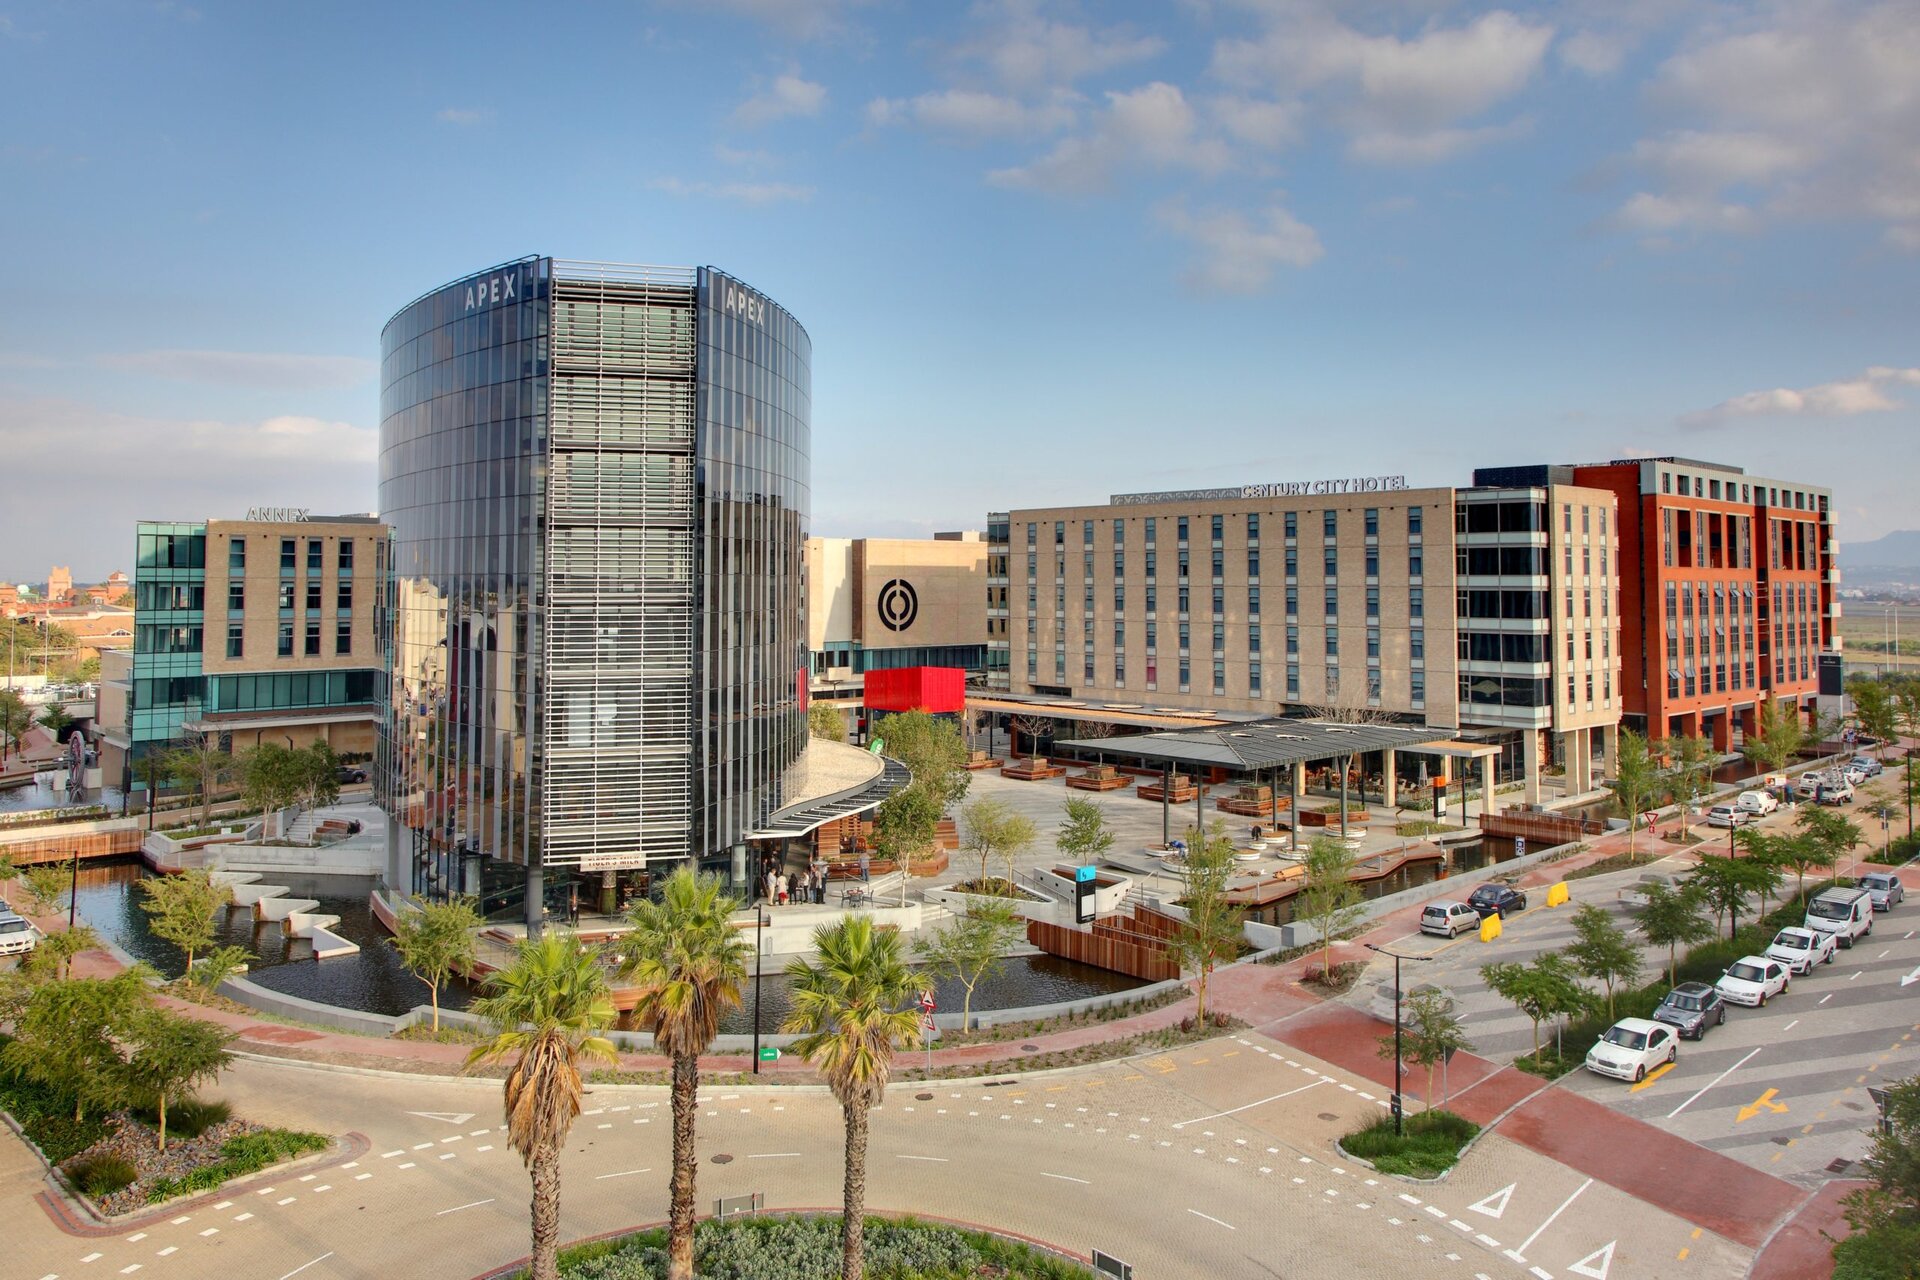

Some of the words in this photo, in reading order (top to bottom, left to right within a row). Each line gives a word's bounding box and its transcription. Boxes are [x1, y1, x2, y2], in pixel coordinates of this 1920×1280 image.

[465, 273, 515, 311] APEX
[726, 286, 764, 327] APEX
[1241, 481, 1310, 498] CENTURY
[1312, 479, 1349, 495] CITY
[1352, 475, 1409, 492] HOTEL
[246, 506, 310, 522] ANNEX
